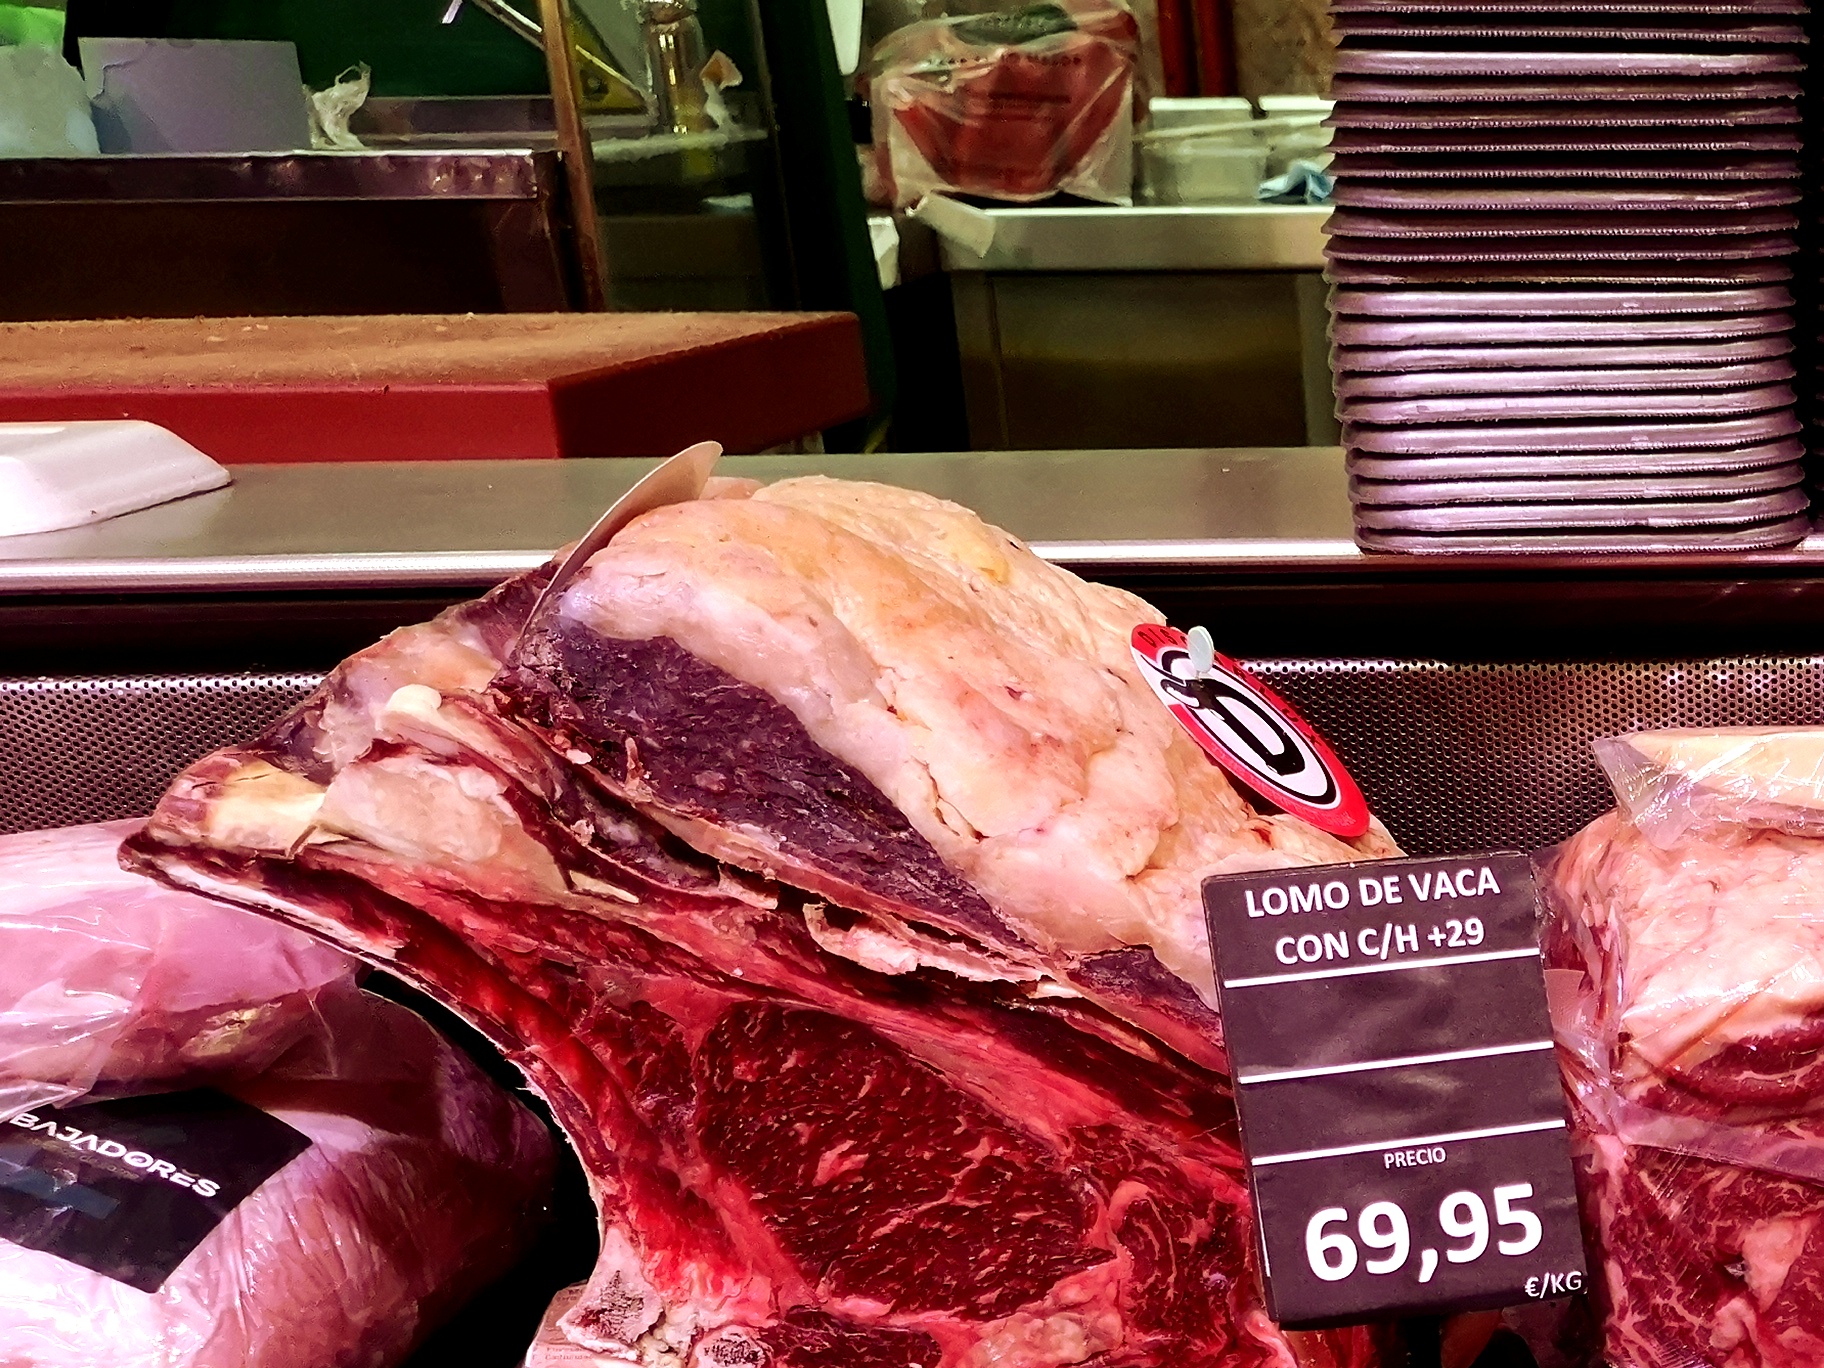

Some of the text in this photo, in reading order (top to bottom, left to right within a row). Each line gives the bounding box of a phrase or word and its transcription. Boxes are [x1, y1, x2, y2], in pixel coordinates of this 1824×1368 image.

[1245, 867, 1500, 919] LOMO DE VACA
[1275, 917, 1485, 966] CON C/H +29
[9, 1112, 222, 1197] BAJADORES
[1383, 1146, 1447, 1169] PRECIO
[1303, 1181, 1545, 1285] 69,95
[1523, 1271, 1584, 1299] €/KG
